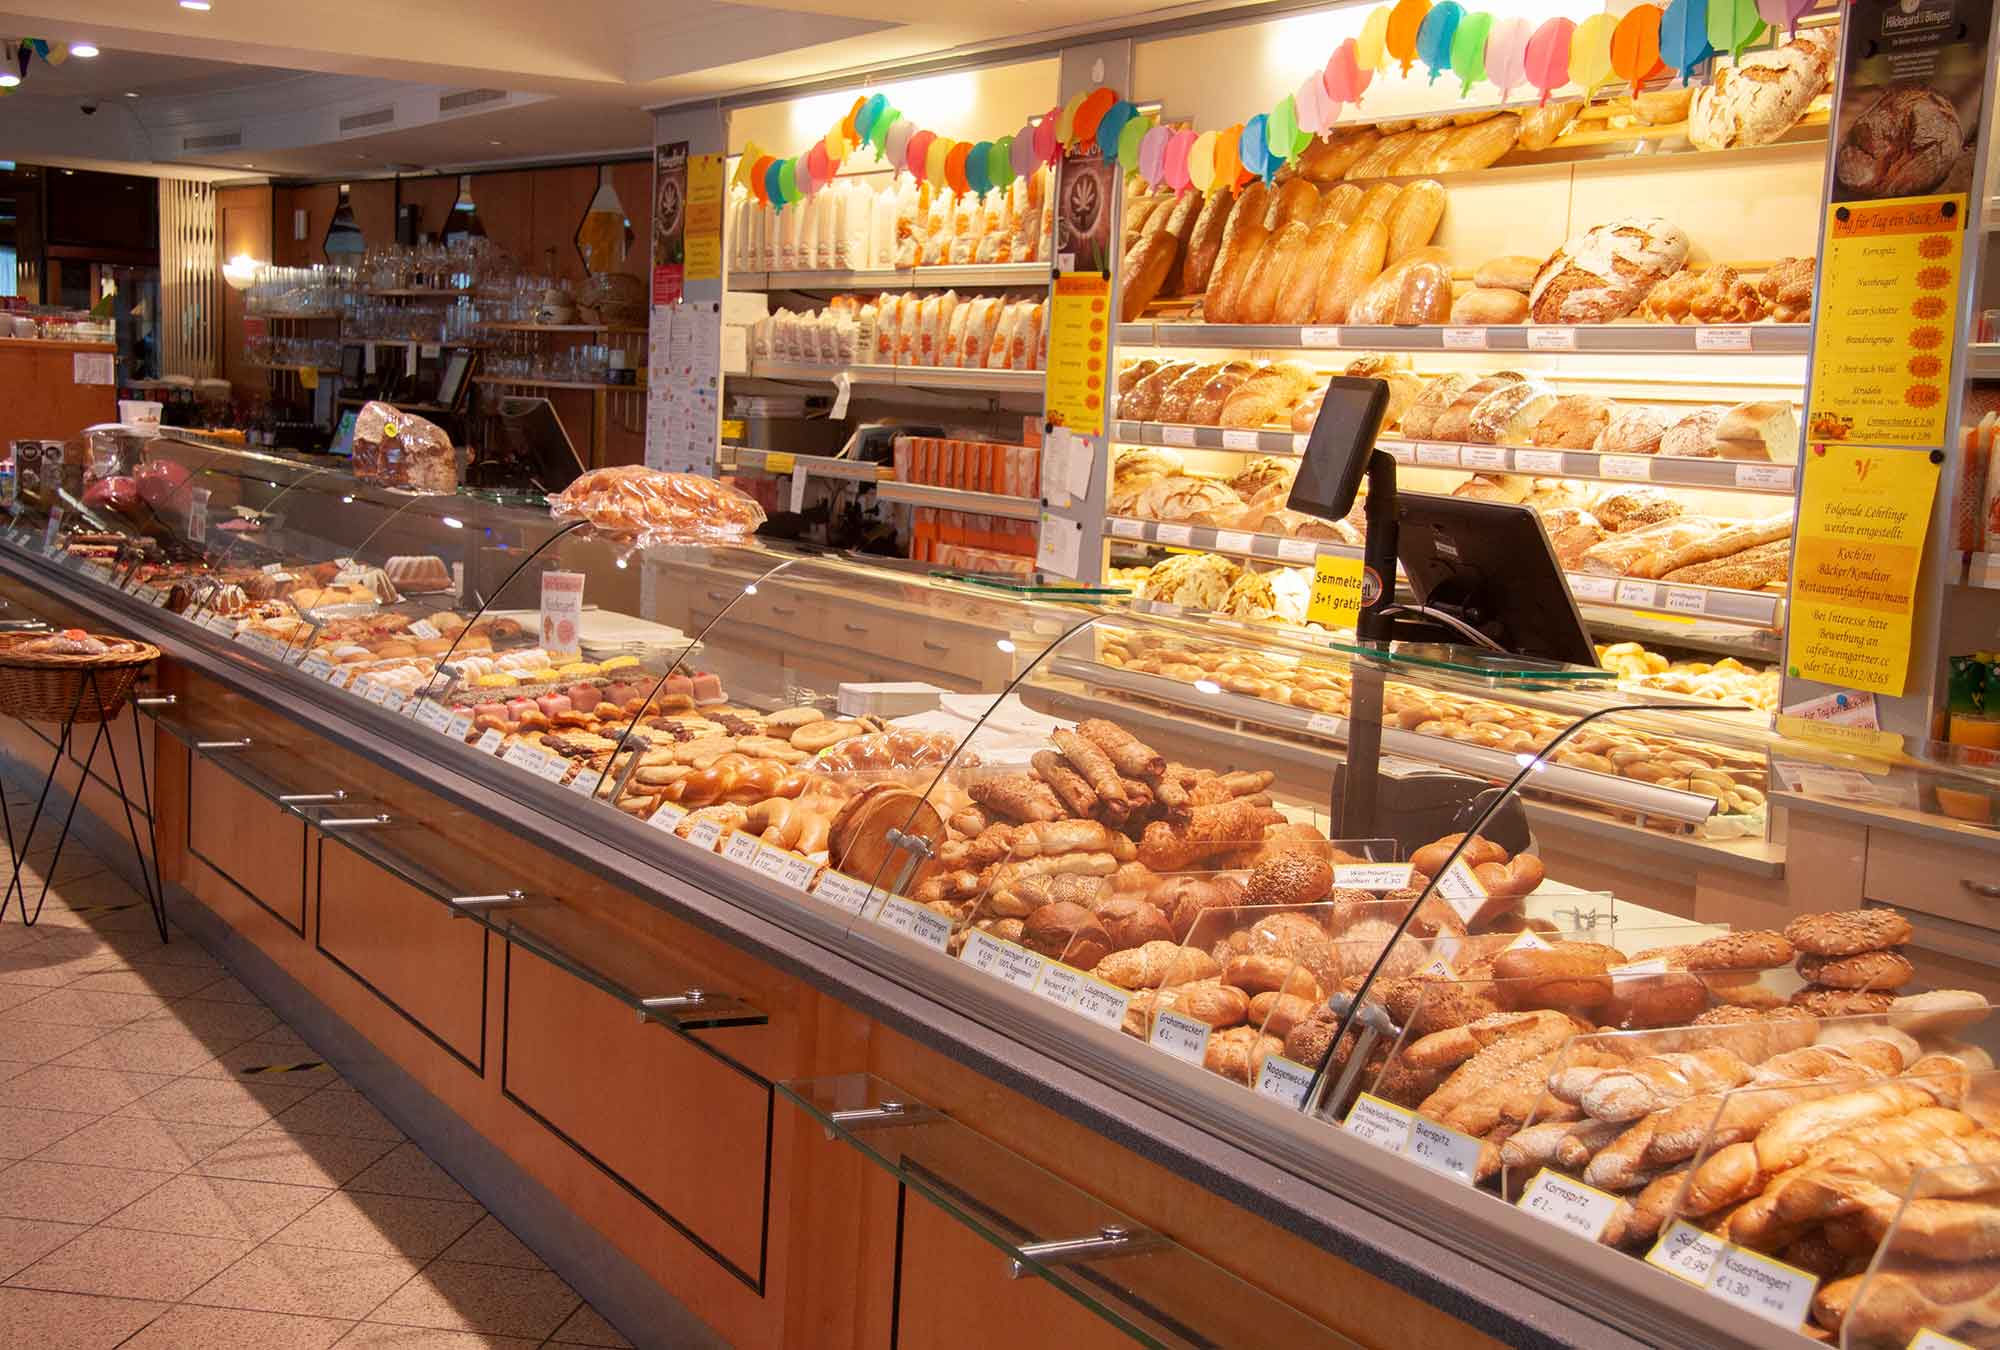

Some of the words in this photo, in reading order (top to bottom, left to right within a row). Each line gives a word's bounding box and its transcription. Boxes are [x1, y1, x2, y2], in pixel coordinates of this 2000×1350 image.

[1825, 503, 1862, 518] Folgende
[1864, 505, 1908, 523] Lehrlinge
[1824, 522, 1854, 536] werden
[1316, 571, 1362, 590] Semmelta
[1315, 592, 1331, 605] 5+1
[1334, 596, 1361, 611] gratis
[1813, 609, 1826, 621] Bei
[1828, 611, 1865, 626] Interesse
[1867, 616, 1888, 630] bitte
[1819, 629, 1865, 648] Bewerbung
[1866, 638, 1879, 647] an
[1803, 660, 1820, 673] oder
[1160, 1012, 1205, 1039] Grahamweckerl
[1266, 1062, 1310, 1089] Roggenwecke
[1416, 1122, 1451, 1147] Bierspitz
[1544, 1180, 1589, 1207] Kornspitz
